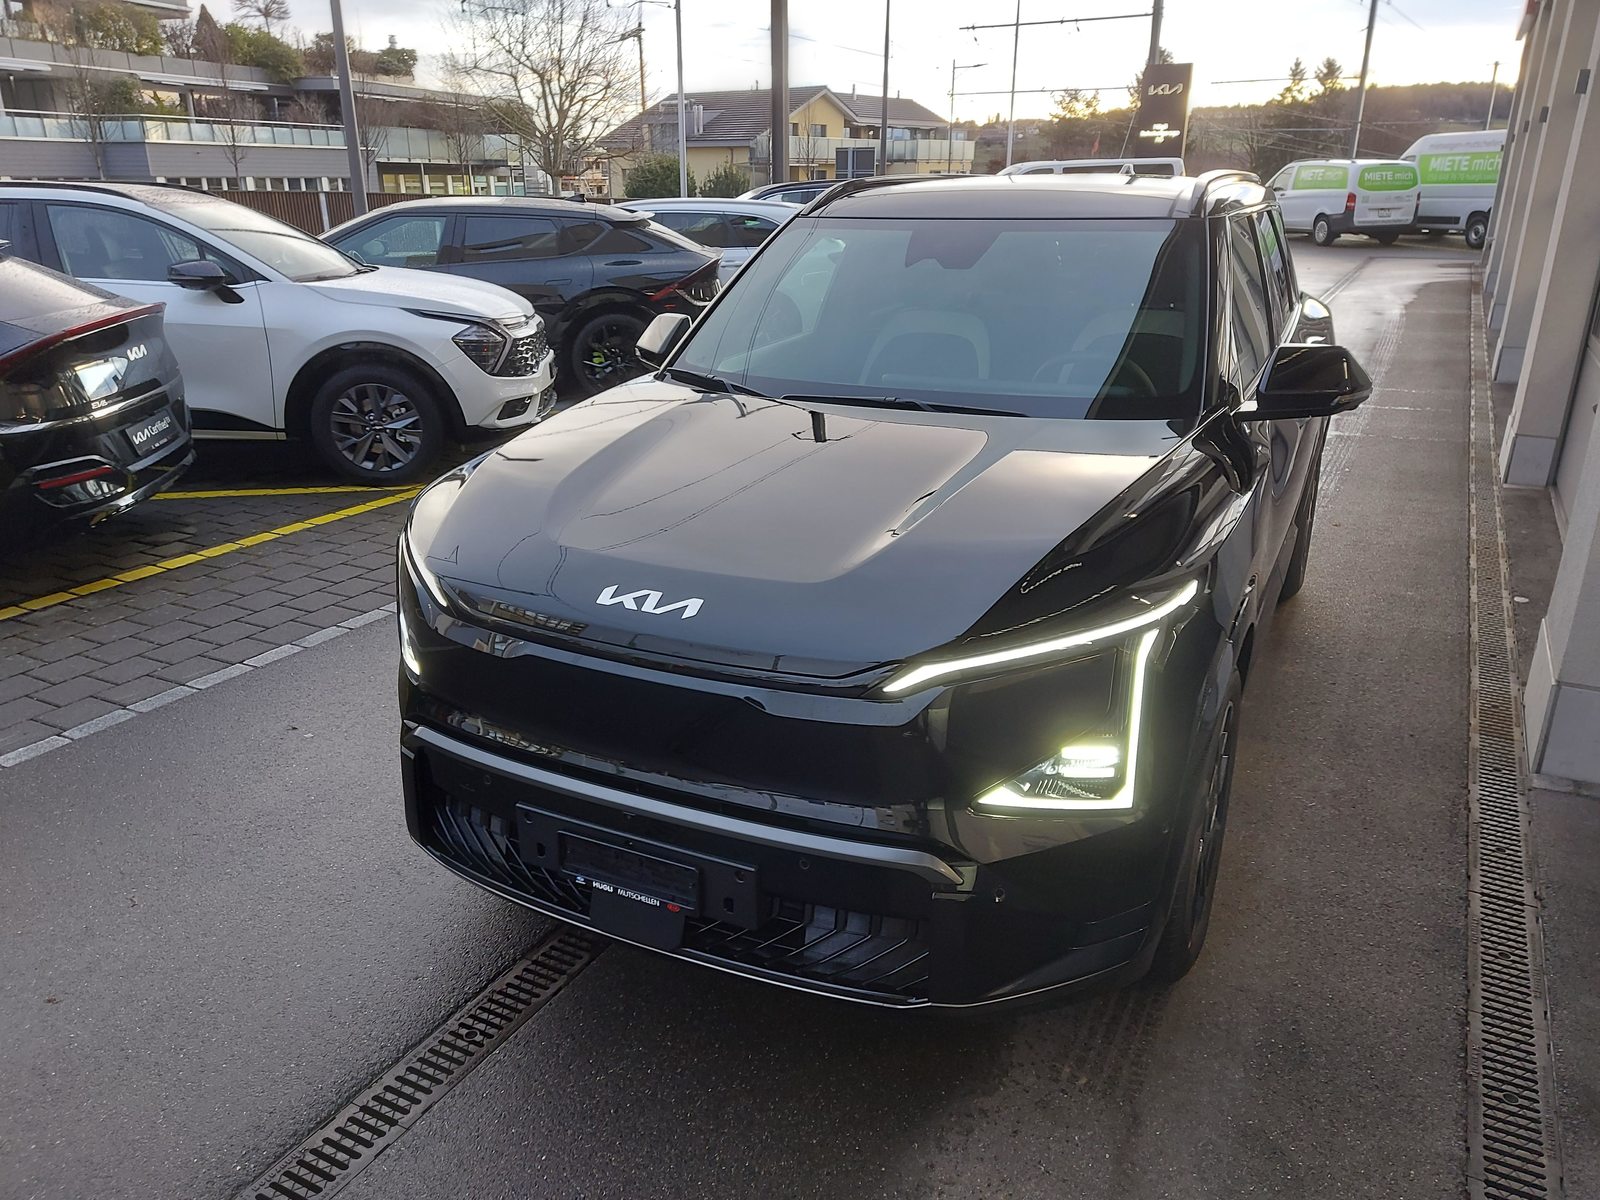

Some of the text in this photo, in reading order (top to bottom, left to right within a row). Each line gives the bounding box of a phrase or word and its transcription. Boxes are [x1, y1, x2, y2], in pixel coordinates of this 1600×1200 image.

[1148, 84, 1183, 95] KIA
[1429, 156, 1471, 171] MIETE
[1364, 171, 1413, 181] MIETE mich
[596, 584, 704, 620] KIA
[617, 888, 660, 907] MUTSCHELLEN
